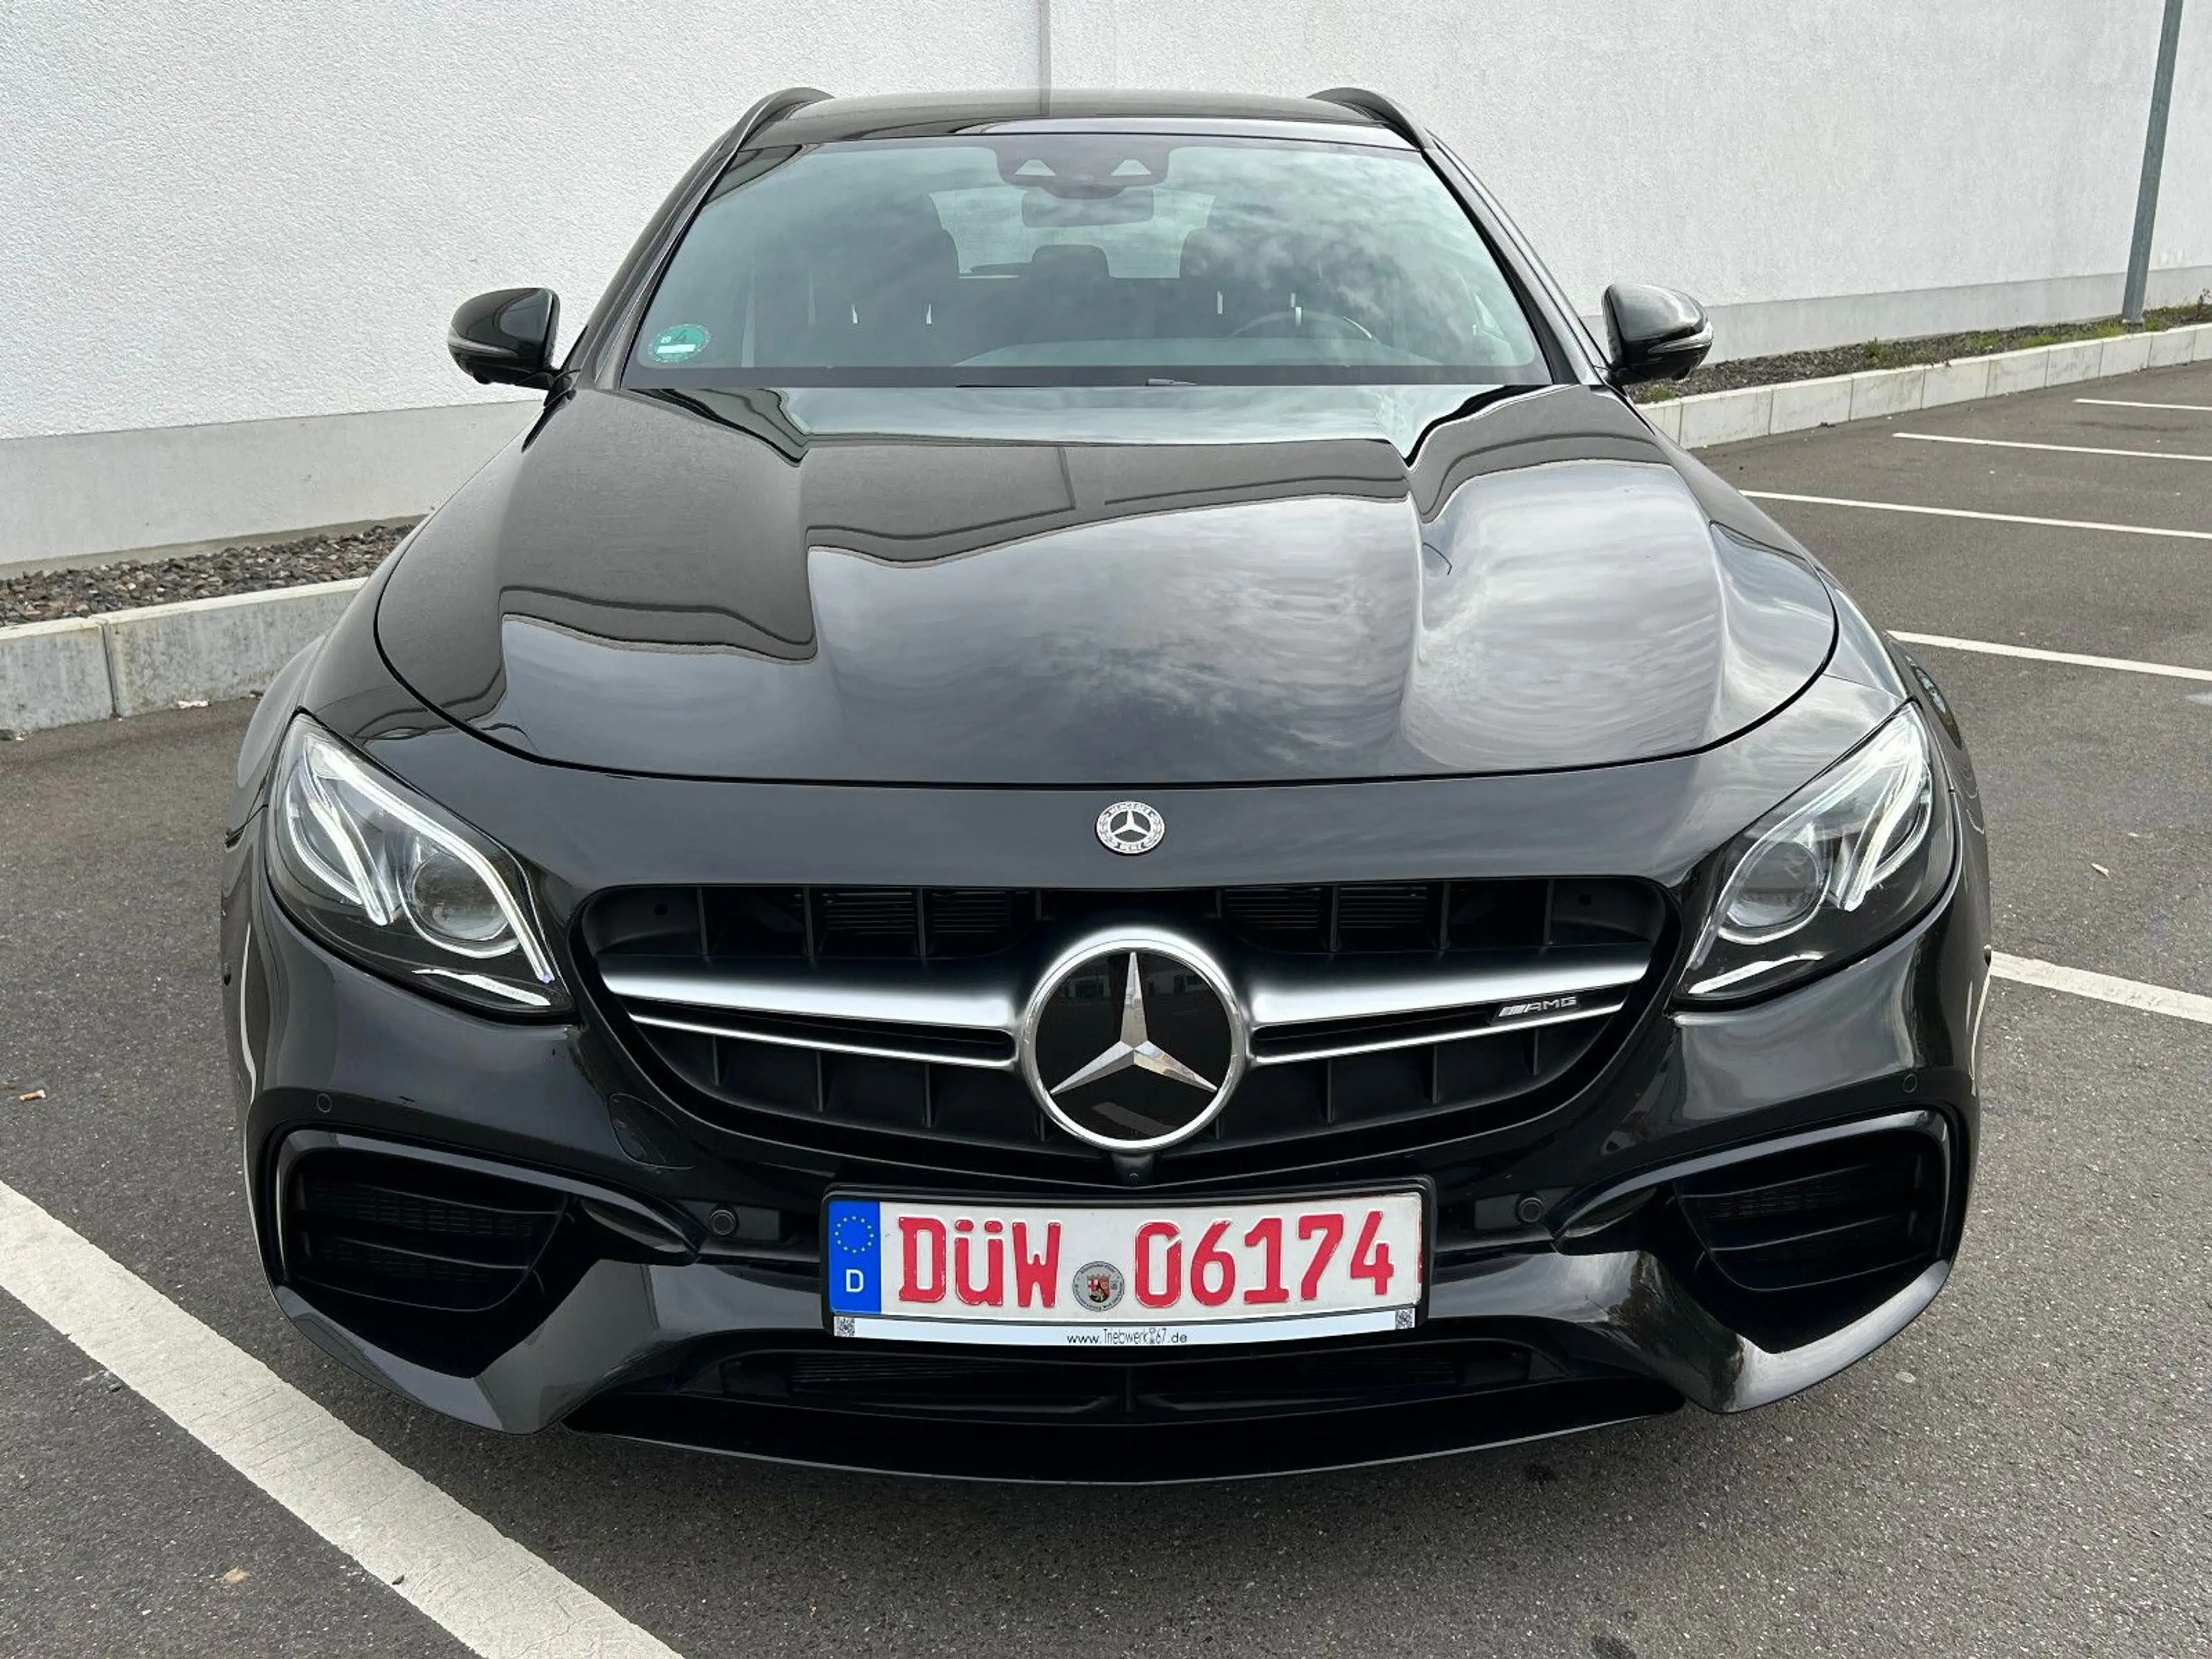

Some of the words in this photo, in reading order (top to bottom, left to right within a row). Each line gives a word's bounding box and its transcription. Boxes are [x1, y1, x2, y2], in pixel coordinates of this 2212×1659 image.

[1525, 996, 1577, 1013] AMG
[898, 1215, 1062, 1308] DÜW
[1134, 1210, 1395, 1308] 06174
[845, 1268, 864, 1293] D
